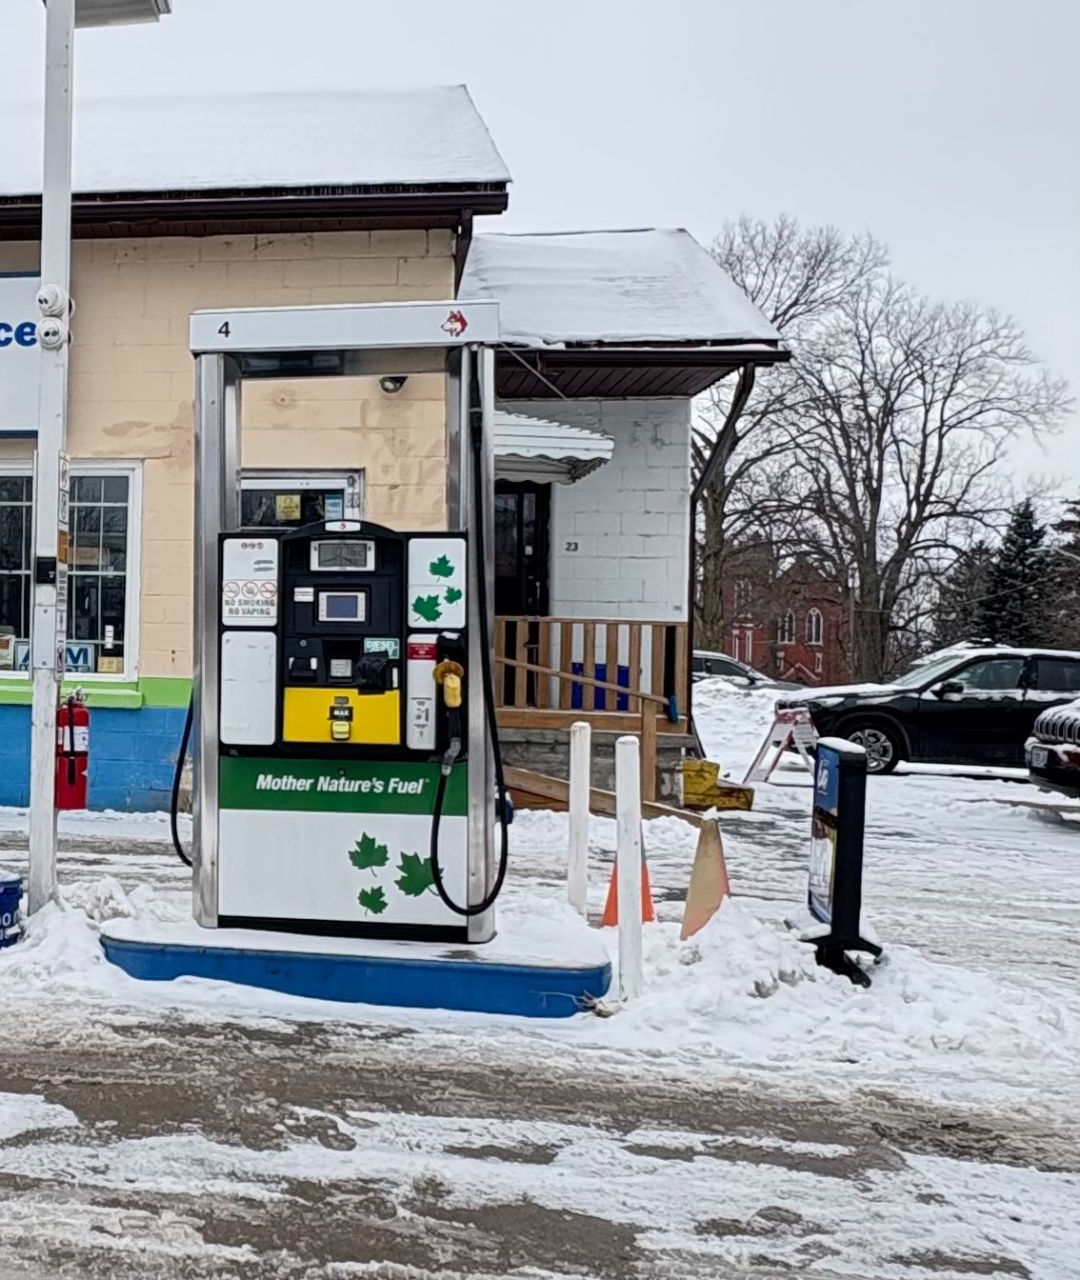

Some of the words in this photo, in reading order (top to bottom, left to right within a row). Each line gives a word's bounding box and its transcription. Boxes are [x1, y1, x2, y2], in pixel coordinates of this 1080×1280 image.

[218, 321, 231, 338] 4
[565, 542, 579, 552] 23
[225, 599, 235, 607] NO
[238, 599, 275, 607] SMOKING
[228, 607, 239, 615] NO
[242, 607, 271, 615] VAPING
[256, 774, 315, 791] Mother
[317, 776, 384, 793] Nature's
[388, 778, 424, 794] Fuel
